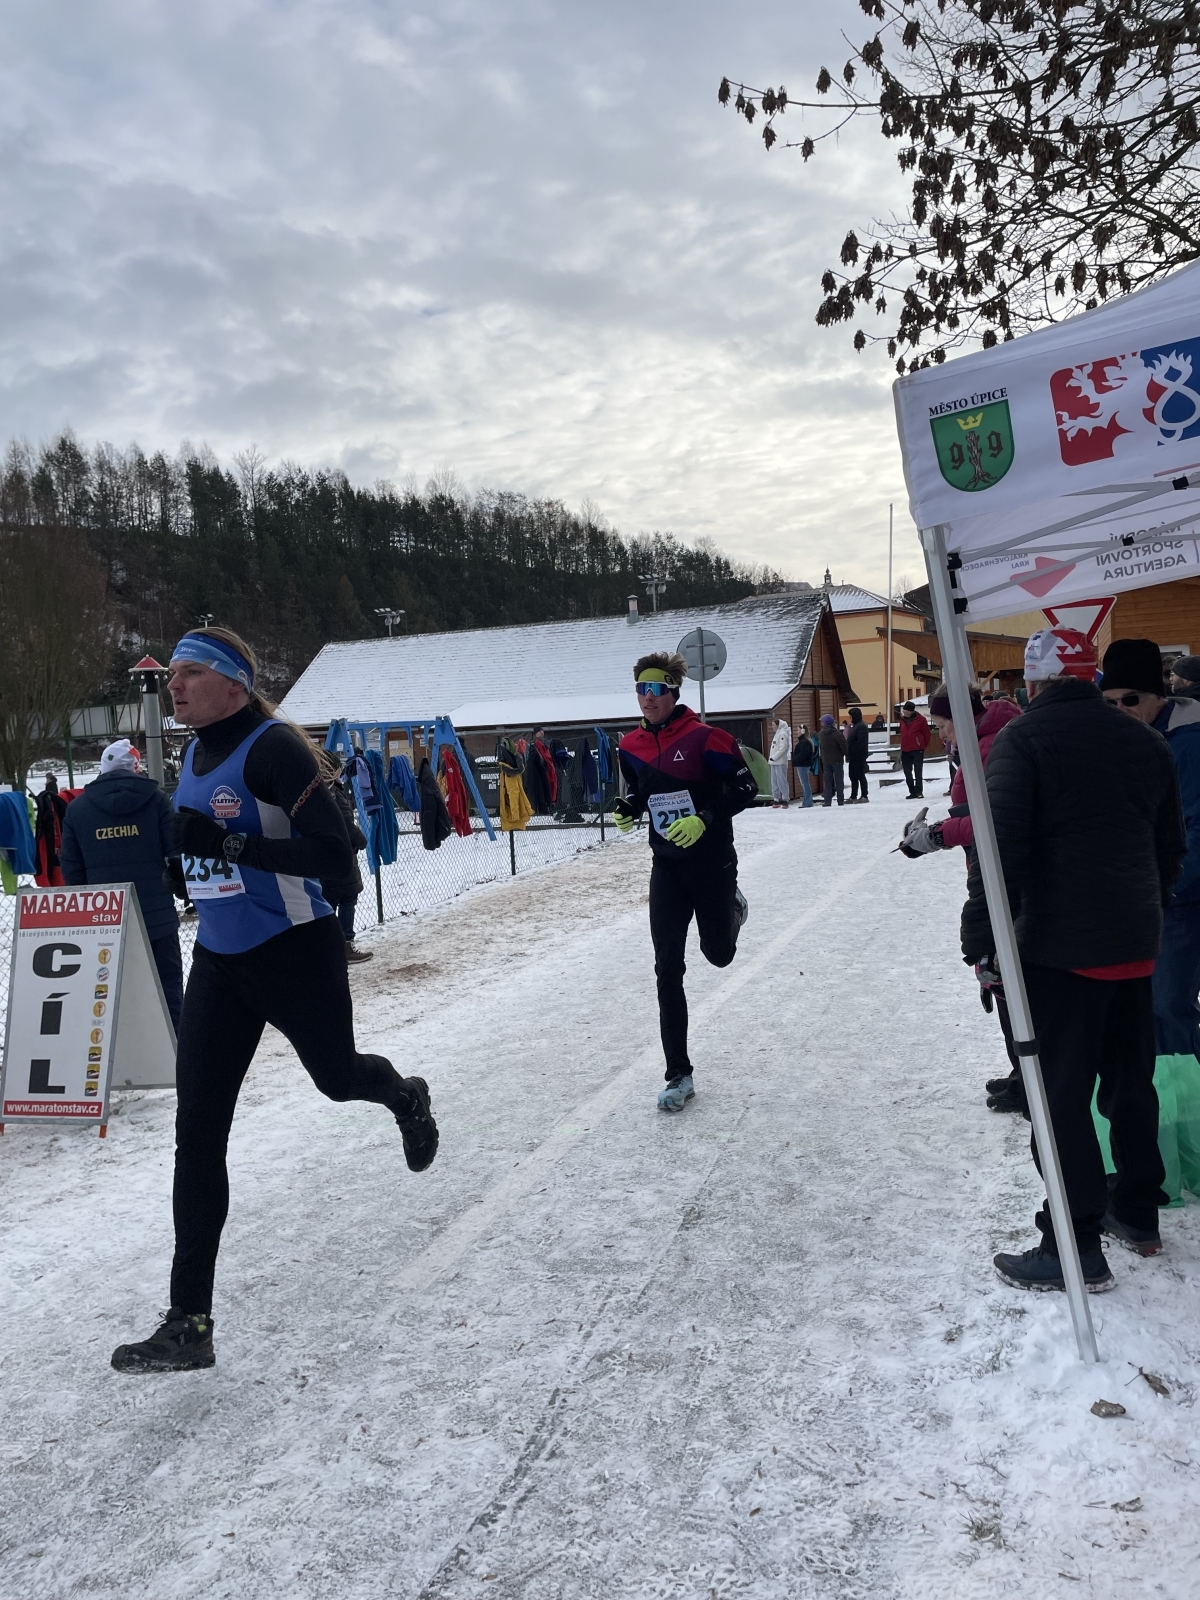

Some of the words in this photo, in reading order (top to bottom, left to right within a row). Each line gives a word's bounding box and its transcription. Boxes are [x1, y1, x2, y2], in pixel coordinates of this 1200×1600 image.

[928, 398, 968, 416] MĚSTO
[970, 387, 1008, 405] ÚPICE
[657, 807, 690, 829] 275
[95, 825, 139, 840] CZECHIA
[184, 855, 234, 882] 234
[21, 890, 124, 914] MARATON
[92, 913, 118, 922] stav
[68, 928, 96, 937] jednota
[100, 927, 120, 935] Úpice
[28, 942, 82, 1094] CÍL
[7, 1103, 98, 1113] www.maratonstav.cz
